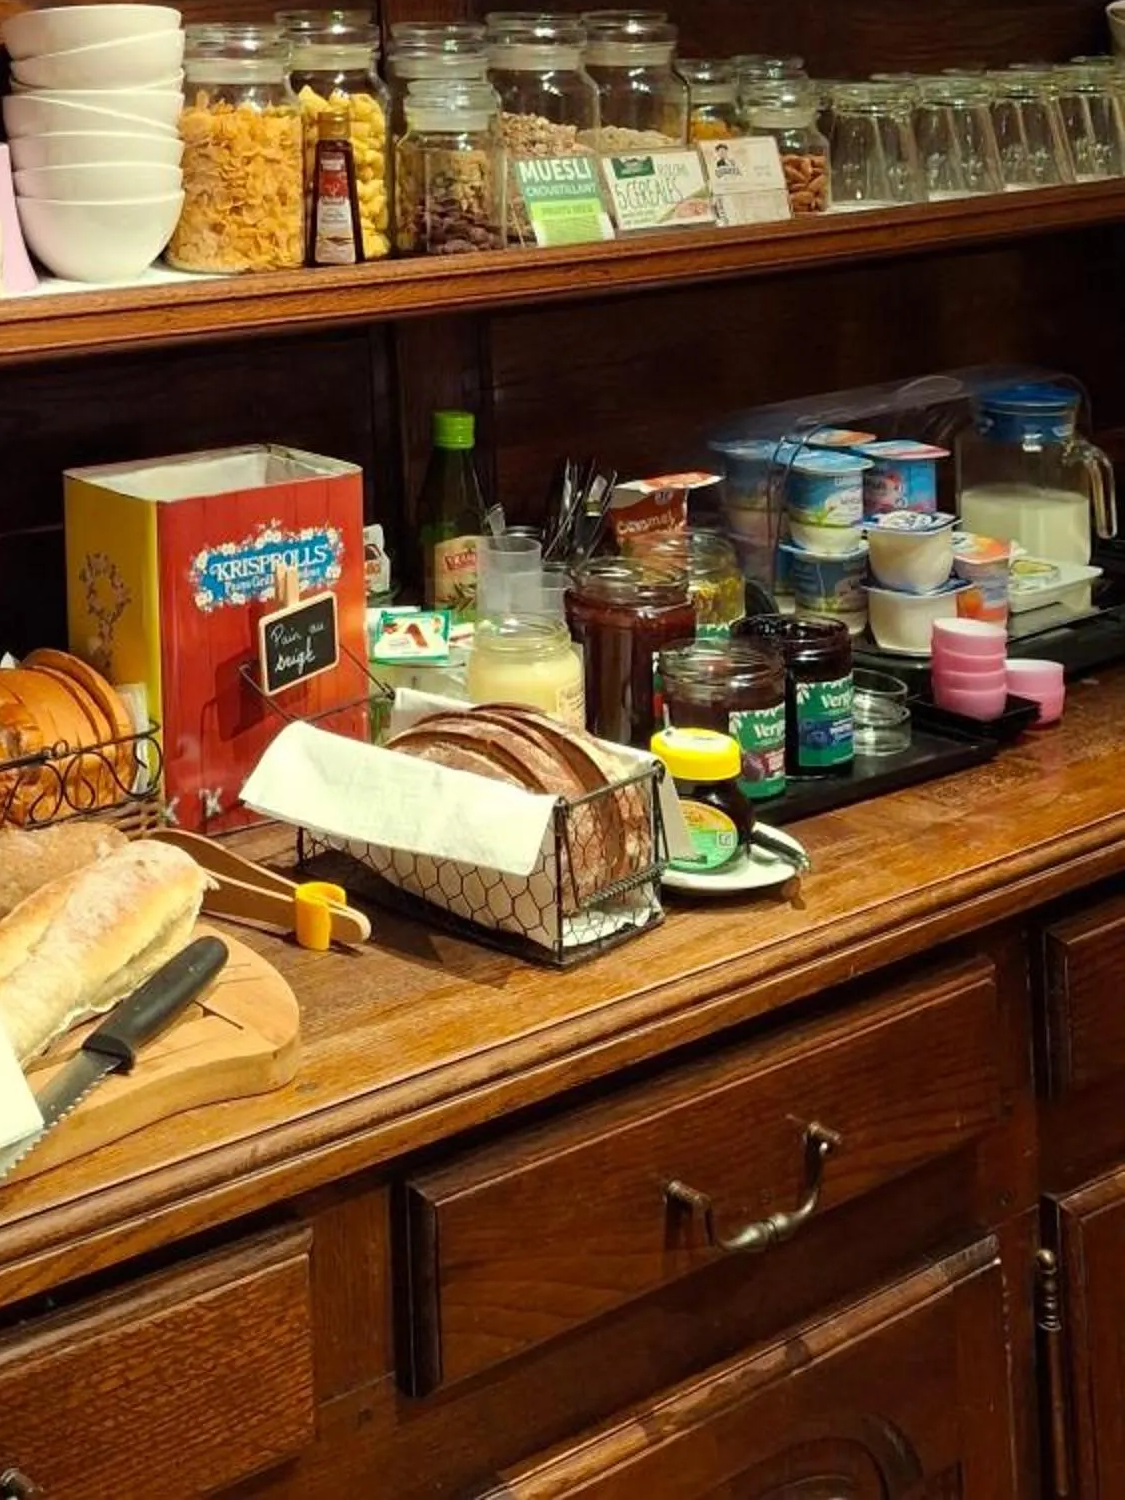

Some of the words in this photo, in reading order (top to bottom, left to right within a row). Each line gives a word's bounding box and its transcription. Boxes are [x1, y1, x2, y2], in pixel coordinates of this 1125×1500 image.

[518, 157, 592, 184] MUESLI
[209, 544, 328, 582] KRISPROLLS
[270, 623, 302, 647] Pain
